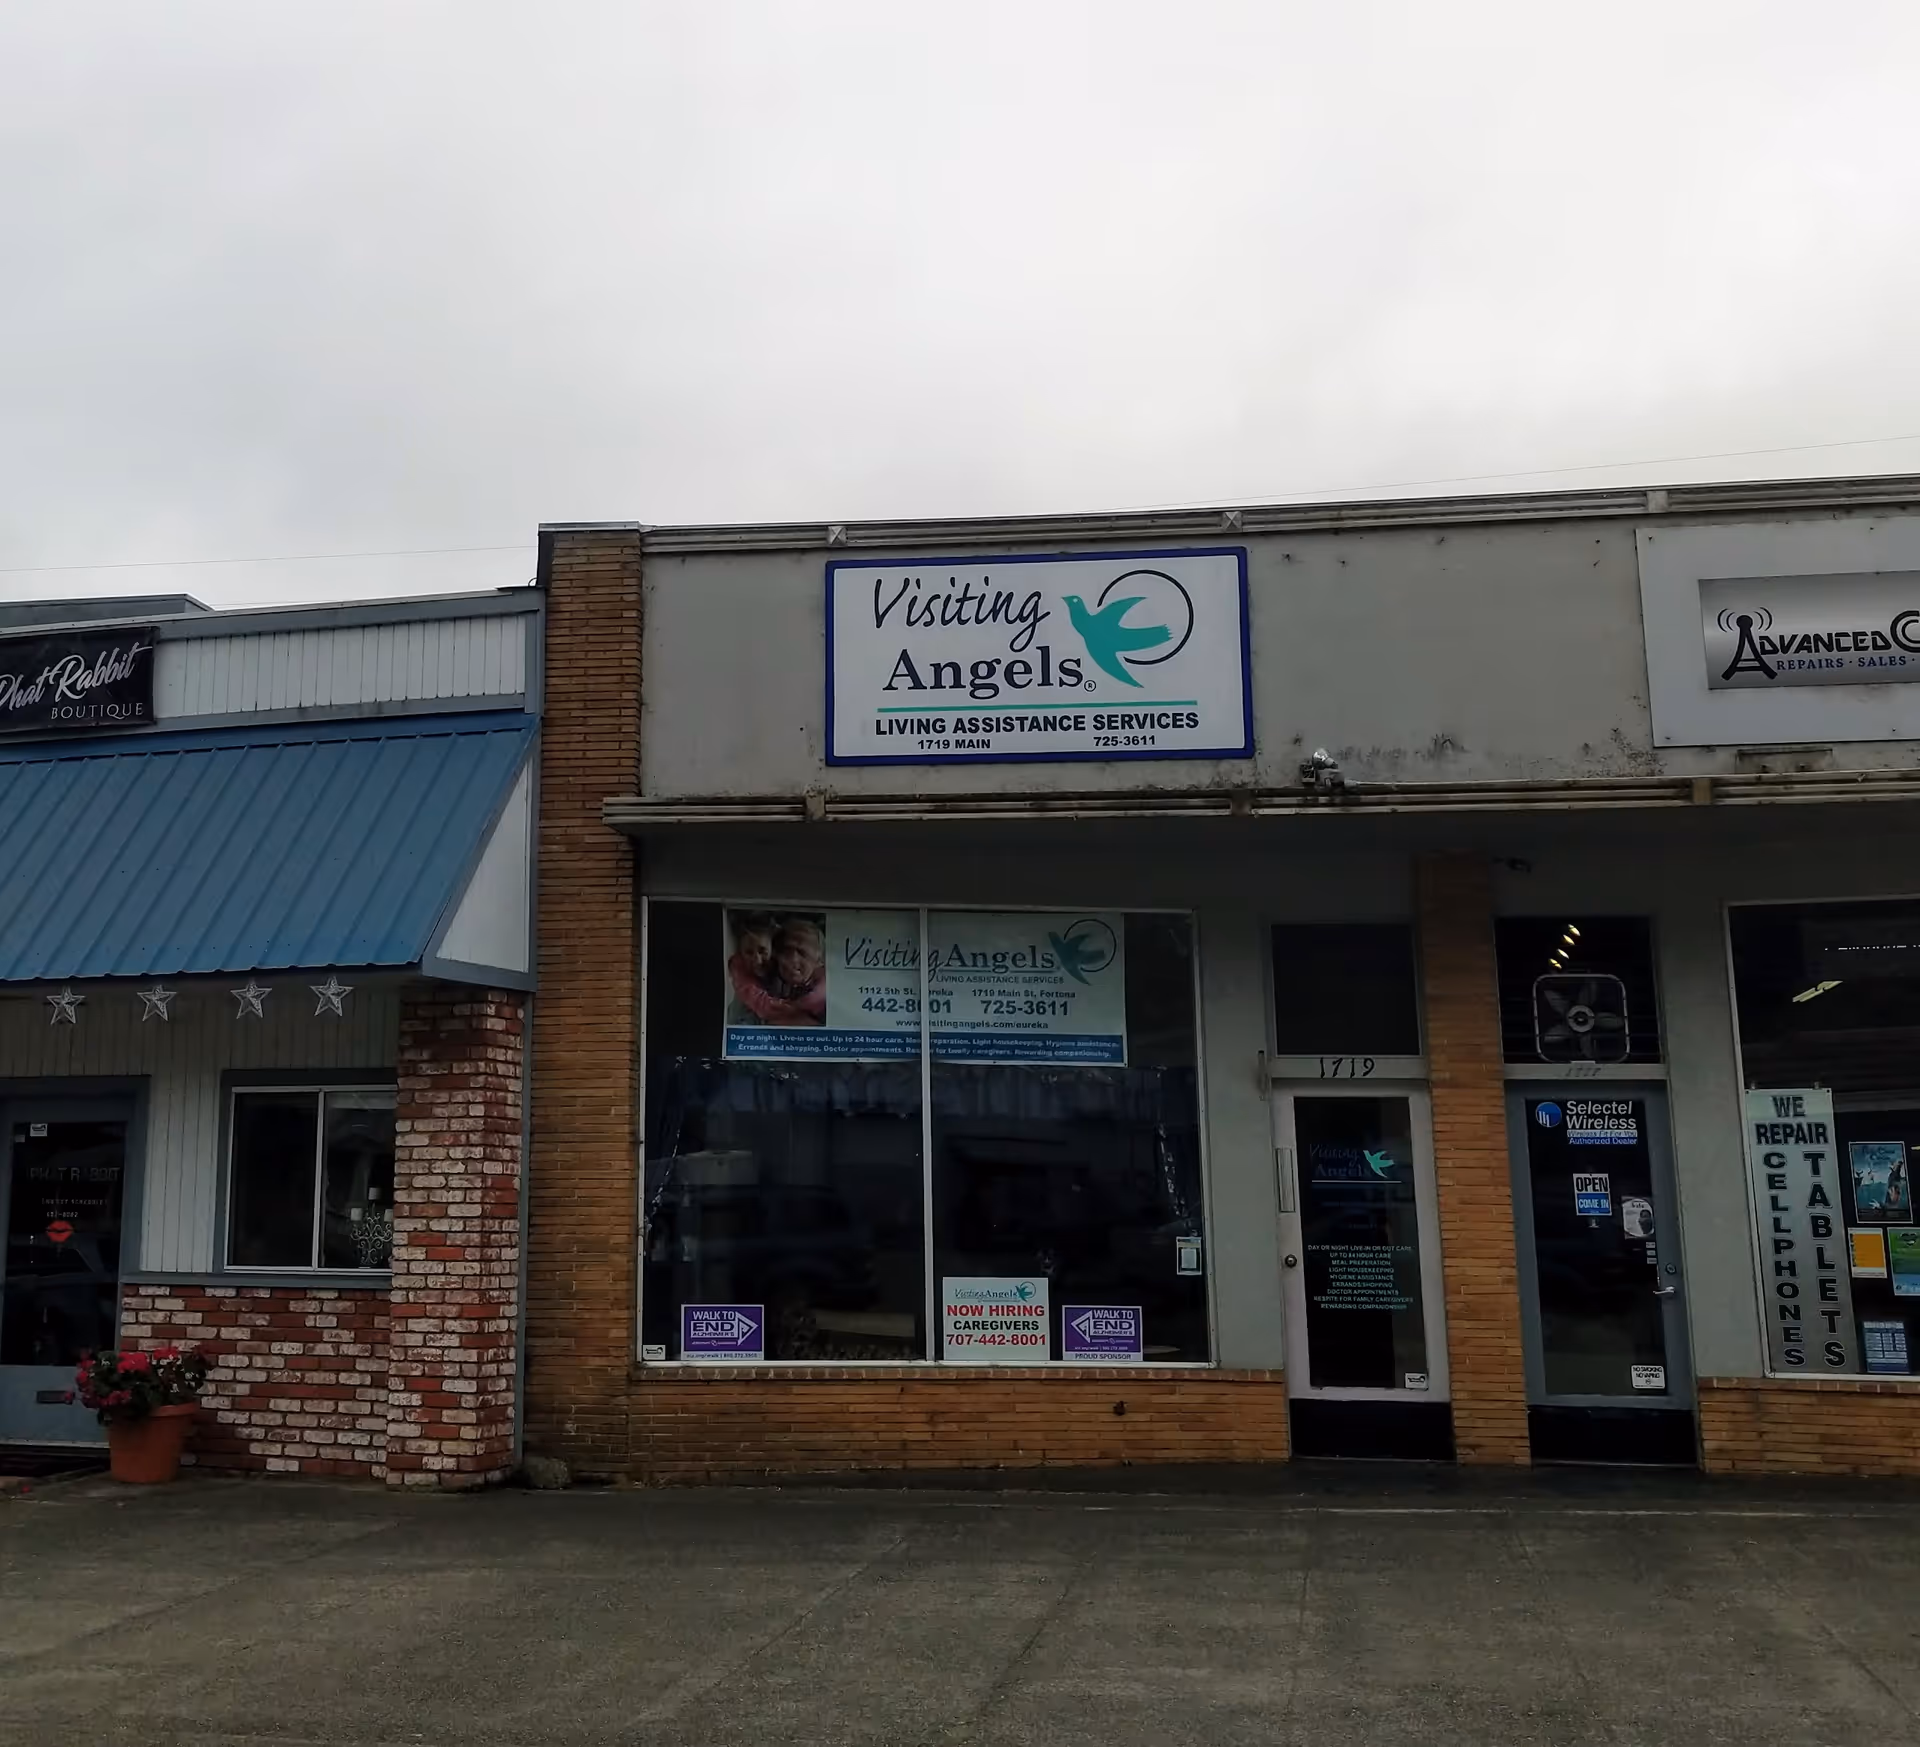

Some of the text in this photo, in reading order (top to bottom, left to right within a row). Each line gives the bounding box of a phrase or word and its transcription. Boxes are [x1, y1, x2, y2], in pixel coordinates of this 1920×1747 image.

[874, 576, 1051, 653] Visiting
[1721, 615, 1891, 681] ADVANCED
[1777, 656, 1906, 671] REPAIRS SALES
[51, 642, 152, 702] Rabbit
[51, 702, 144, 720] BOUTIQUE
[875, 712, 1199, 735] LIVING ASSISTANCE SERVICES
[918, 735, 1156, 750] 1719 MAIN 725-3611
[846, 937, 1054, 984] Visiting Angels
[936, 975, 1064, 984] LIVING ASSISTANCE SERVICES
[980, 999, 1068, 1016] 725-3611
[1320, 1057, 1375, 1079] 1719
[1566, 1100, 1633, 1115] Selectel
[1772, 1096, 1806, 1118] WE
[1566, 1115, 1637, 1130] Wireless
[1755, 1122, 1828, 1145] REPAIR
[1576, 1177, 1608, 1192] OPEN
[1579, 1199, 1610, 1208] COME IN
[1803, 1152, 1846, 1367] TABLETS
[693, 1311, 735, 1320] WALK TO
[946, 1305, 1045, 1316] NOW HIRING
[1093, 1309, 1134, 1319] WALK TO
[693, 1321, 735, 1332] END
[953, 1320, 1039, 1331] CAREGIVERS
[1093, 1320, 1133, 1330] END
[946, 1333, 1046, 1346] 707-442-8001
